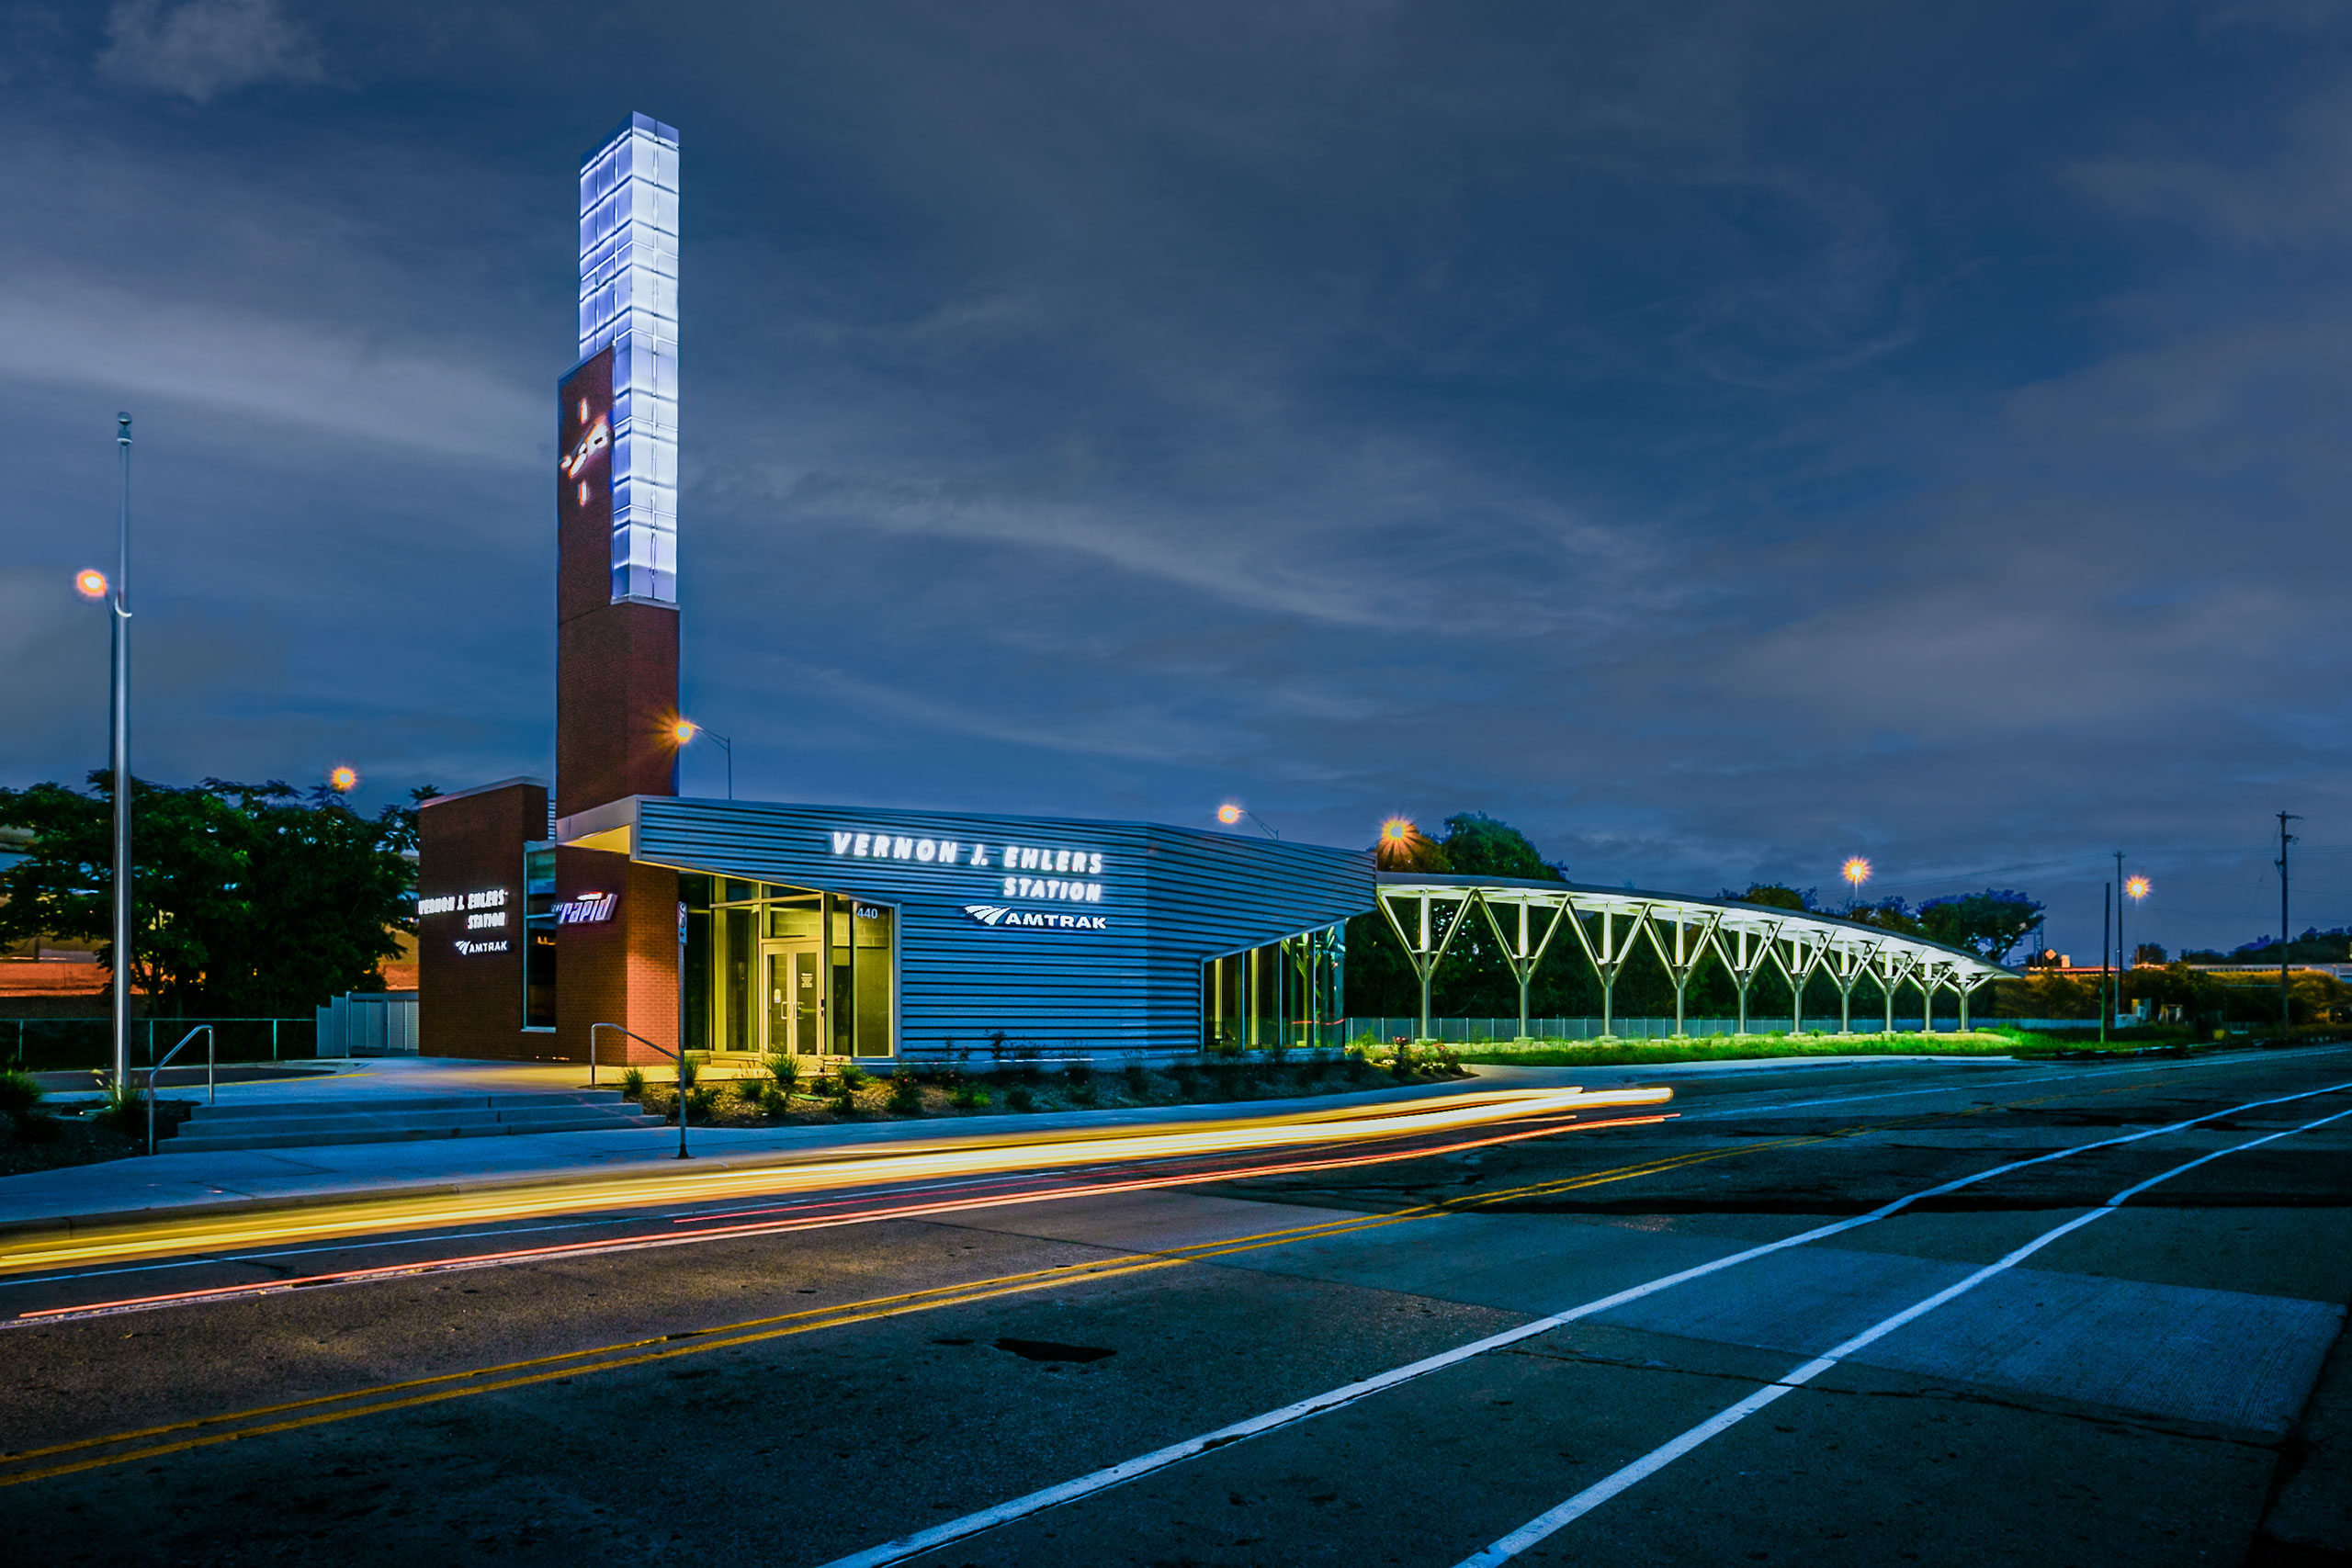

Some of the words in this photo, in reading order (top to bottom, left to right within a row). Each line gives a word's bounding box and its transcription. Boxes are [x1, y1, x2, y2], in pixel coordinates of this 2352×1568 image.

[833, 831, 957, 863] VERNON
[970, 843, 988, 866] J.
[1004, 846, 1102, 874] EHLERS
[1003, 877, 1102, 902] STATION
[467, 912, 506, 930] STATION
[857, 908, 878, 919] 440
[1005, 912, 1107, 930] AMTRAK
[469, 941, 508, 953] AMTRAK
